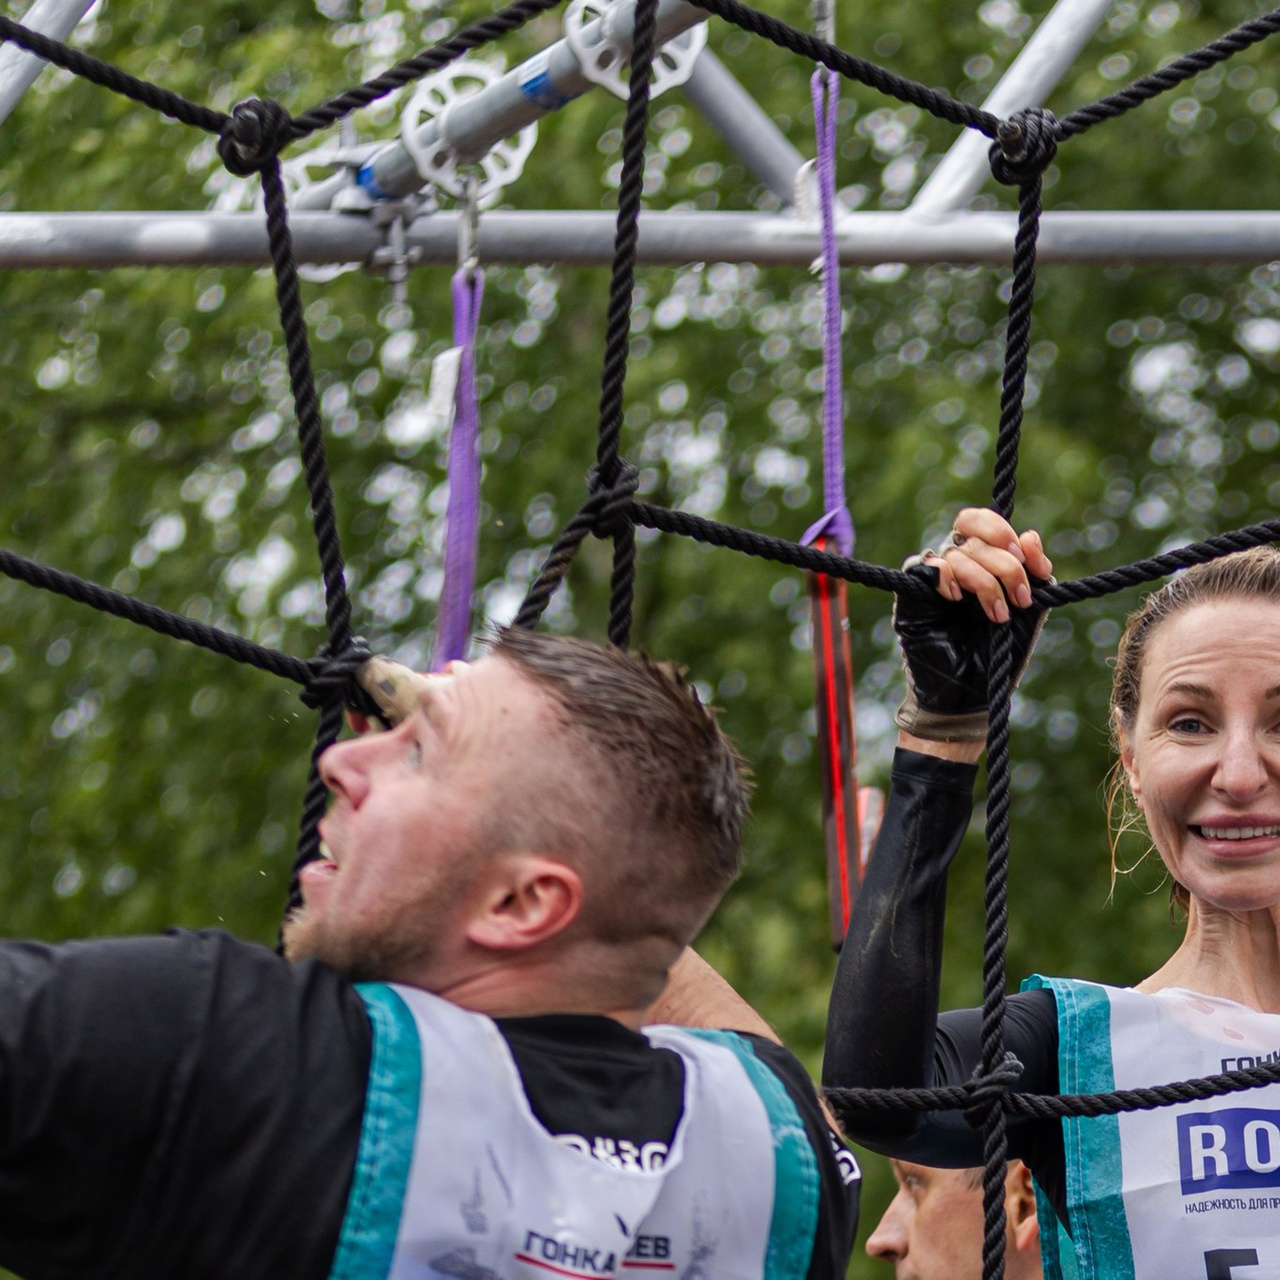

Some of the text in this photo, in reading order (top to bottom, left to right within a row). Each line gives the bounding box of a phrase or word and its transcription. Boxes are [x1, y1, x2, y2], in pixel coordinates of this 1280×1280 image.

[1185, 1198, 1246, 1214] НАДЕЖНОСТЬ
[1248, 1198, 1268, 1210] ДЛЯ
[523, 1229, 617, 1274] ГОНКА
